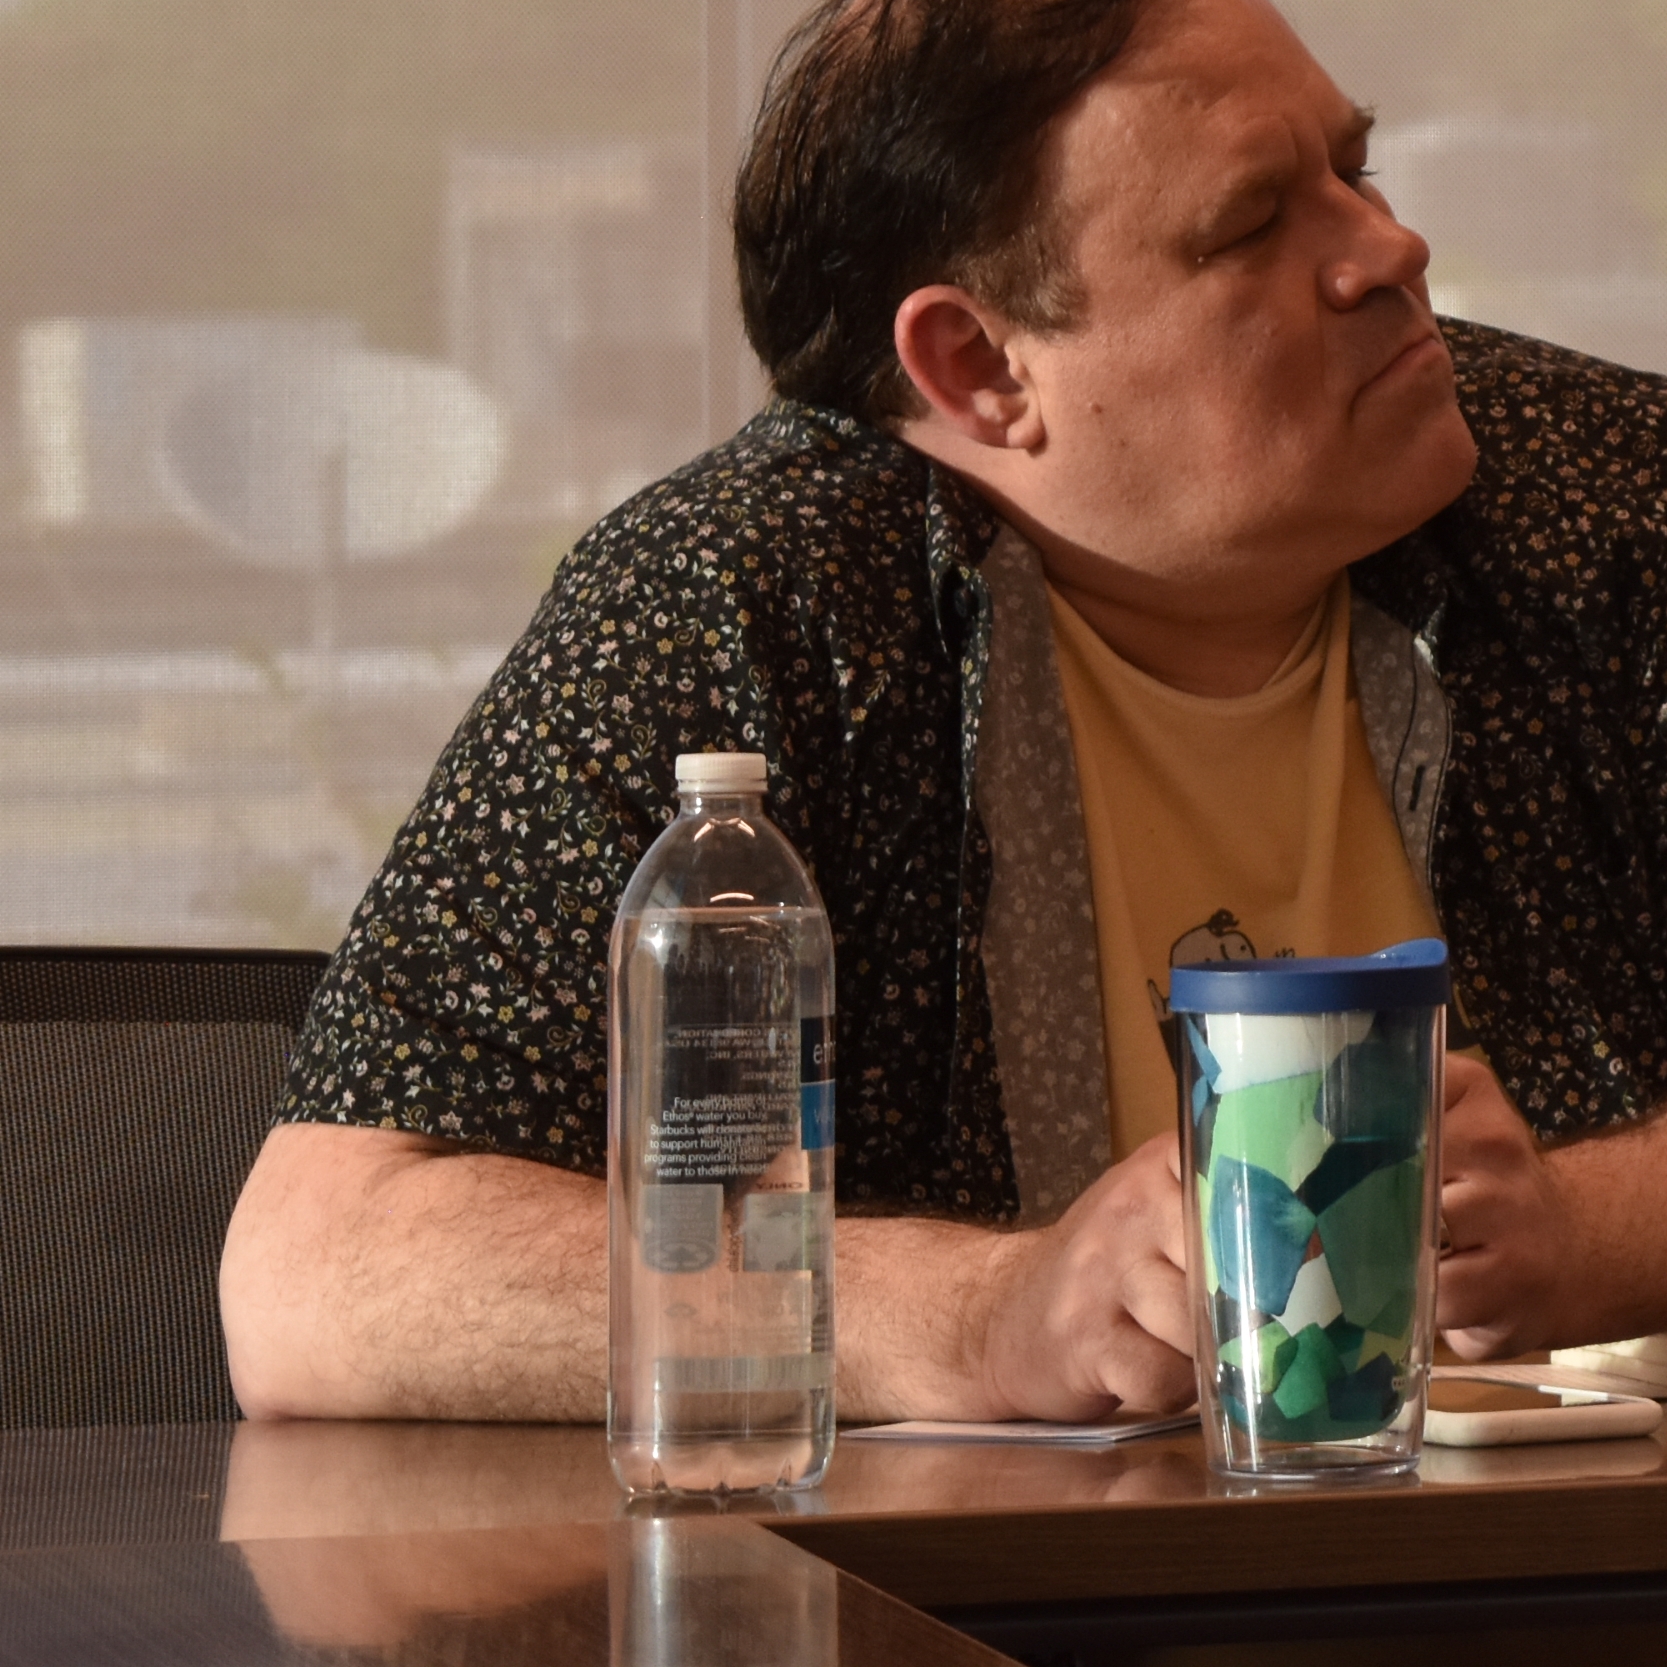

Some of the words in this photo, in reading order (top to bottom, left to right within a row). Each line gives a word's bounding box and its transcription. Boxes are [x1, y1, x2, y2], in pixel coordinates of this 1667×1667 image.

[674, 1097, 691, 1107] For
[693, 1098, 721, 1111] every
[696, 1112, 723, 1122] water
[727, 1113, 746, 1124] you
[651, 1124, 695, 1135] Starbucks
[697, 1124, 714, 1135] will
[651, 1140, 659, 1149] to
[661, 1140, 698, 1152] support
[644, 1153, 686, 1164] programs
[689, 1152, 737, 1164] providing
[657, 1166, 682, 1176] water
[685, 1166, 695, 1176] to
[698, 1166, 726, 1176] those
